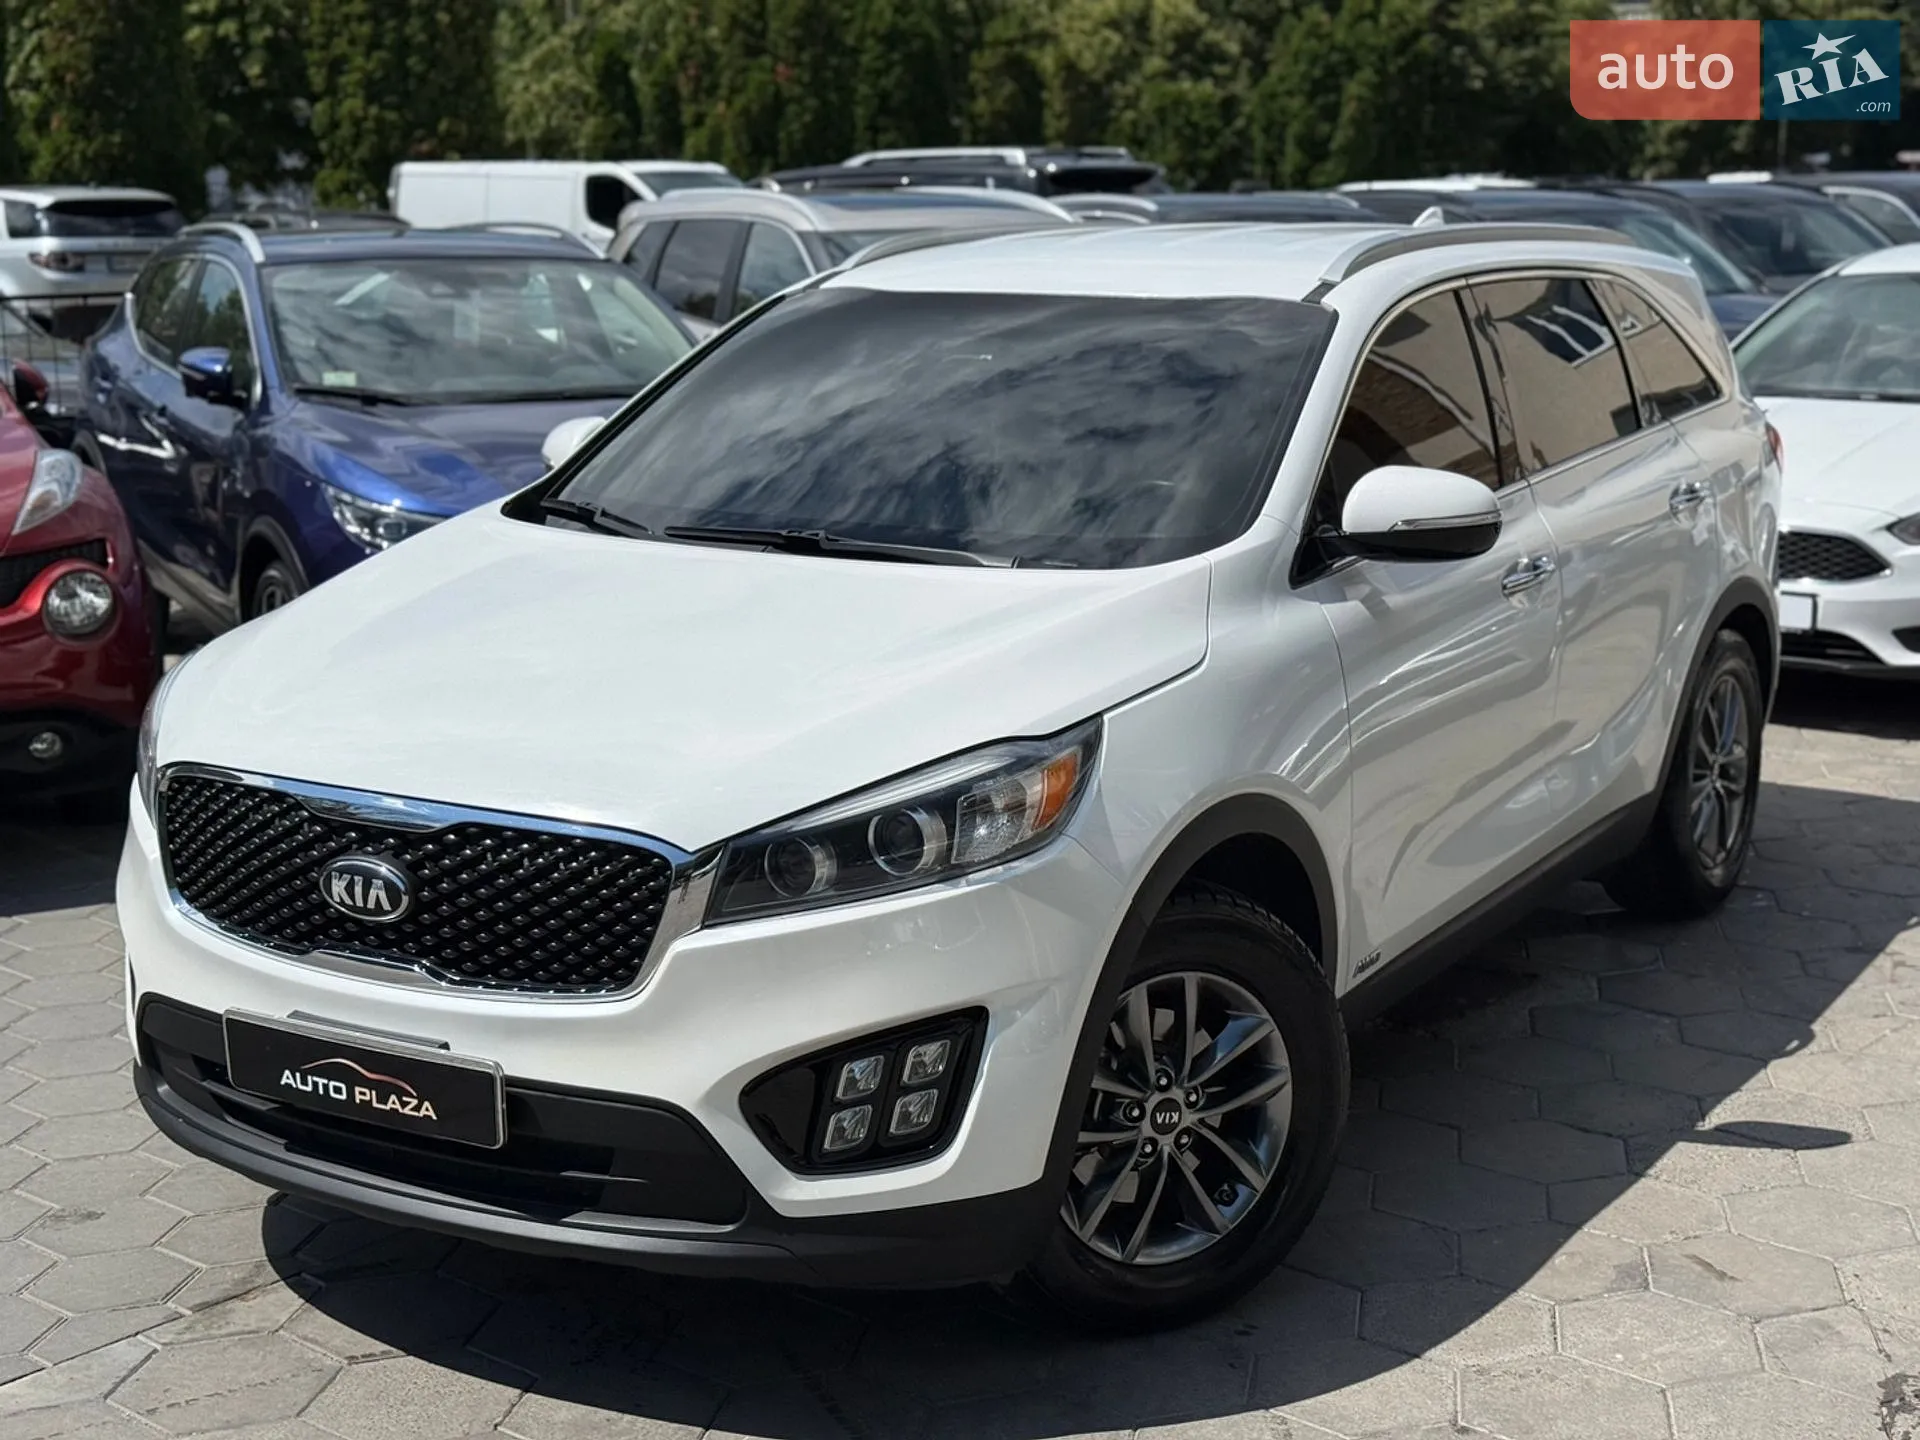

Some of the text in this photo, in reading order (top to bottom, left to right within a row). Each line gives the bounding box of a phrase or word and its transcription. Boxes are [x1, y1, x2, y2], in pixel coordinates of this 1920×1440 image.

[330, 871, 392, 911] KIA
[280, 1069, 437, 1120] AUTO PLAZA
[1155, 1111, 1179, 1124] KIA
